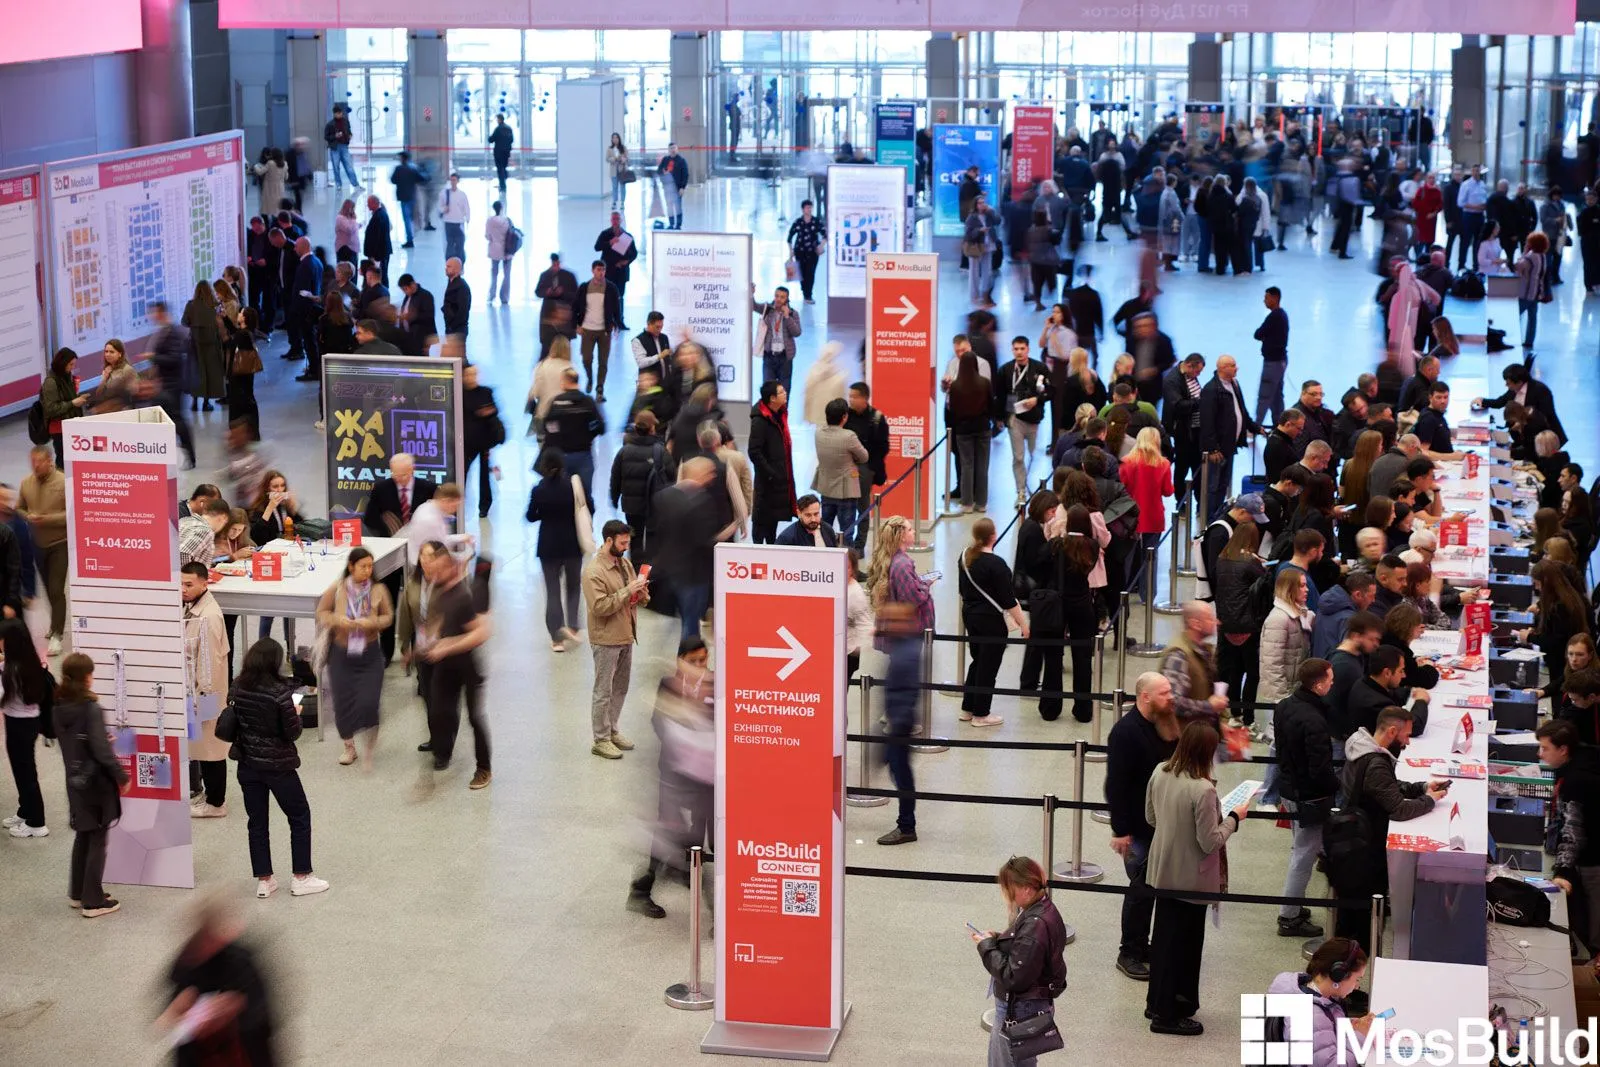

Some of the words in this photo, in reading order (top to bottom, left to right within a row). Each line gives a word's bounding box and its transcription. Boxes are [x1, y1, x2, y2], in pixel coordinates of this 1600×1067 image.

[71, 176, 93, 188] MosBuild
[666, 248, 710, 256] AGALAROV
[897, 264, 931, 272] MosBuild
[693, 284, 730, 292] КРЕДИТЫ
[703, 293, 719, 301] ДЛЯ
[688, 317, 735, 325] БАНКОВСКИЕ
[693, 326, 731, 334] ГАРАНТИИ
[876, 330, 926, 339] РЕГИСТРАЦИЯ
[876, 339, 926, 347] ПОСЕТИТЕЛЕЙ
[400, 420, 437, 440] FM
[112, 441, 167, 454] MosBuild
[401, 440, 437, 458] 100.5
[337, 466, 447, 484] КАЧЕТ
[772, 569, 834, 583] MosBuild
[734, 689, 820, 703] РЕГИСТРАЦИЯ
[734, 703, 815, 717] УЧАСТНИКОВ
[734, 724, 782, 734] EXHIBITOR
[734, 735, 800, 746] REGISTRATION
[737, 840, 820, 861] MosBuild
[761, 862, 817, 874] CONNECT
